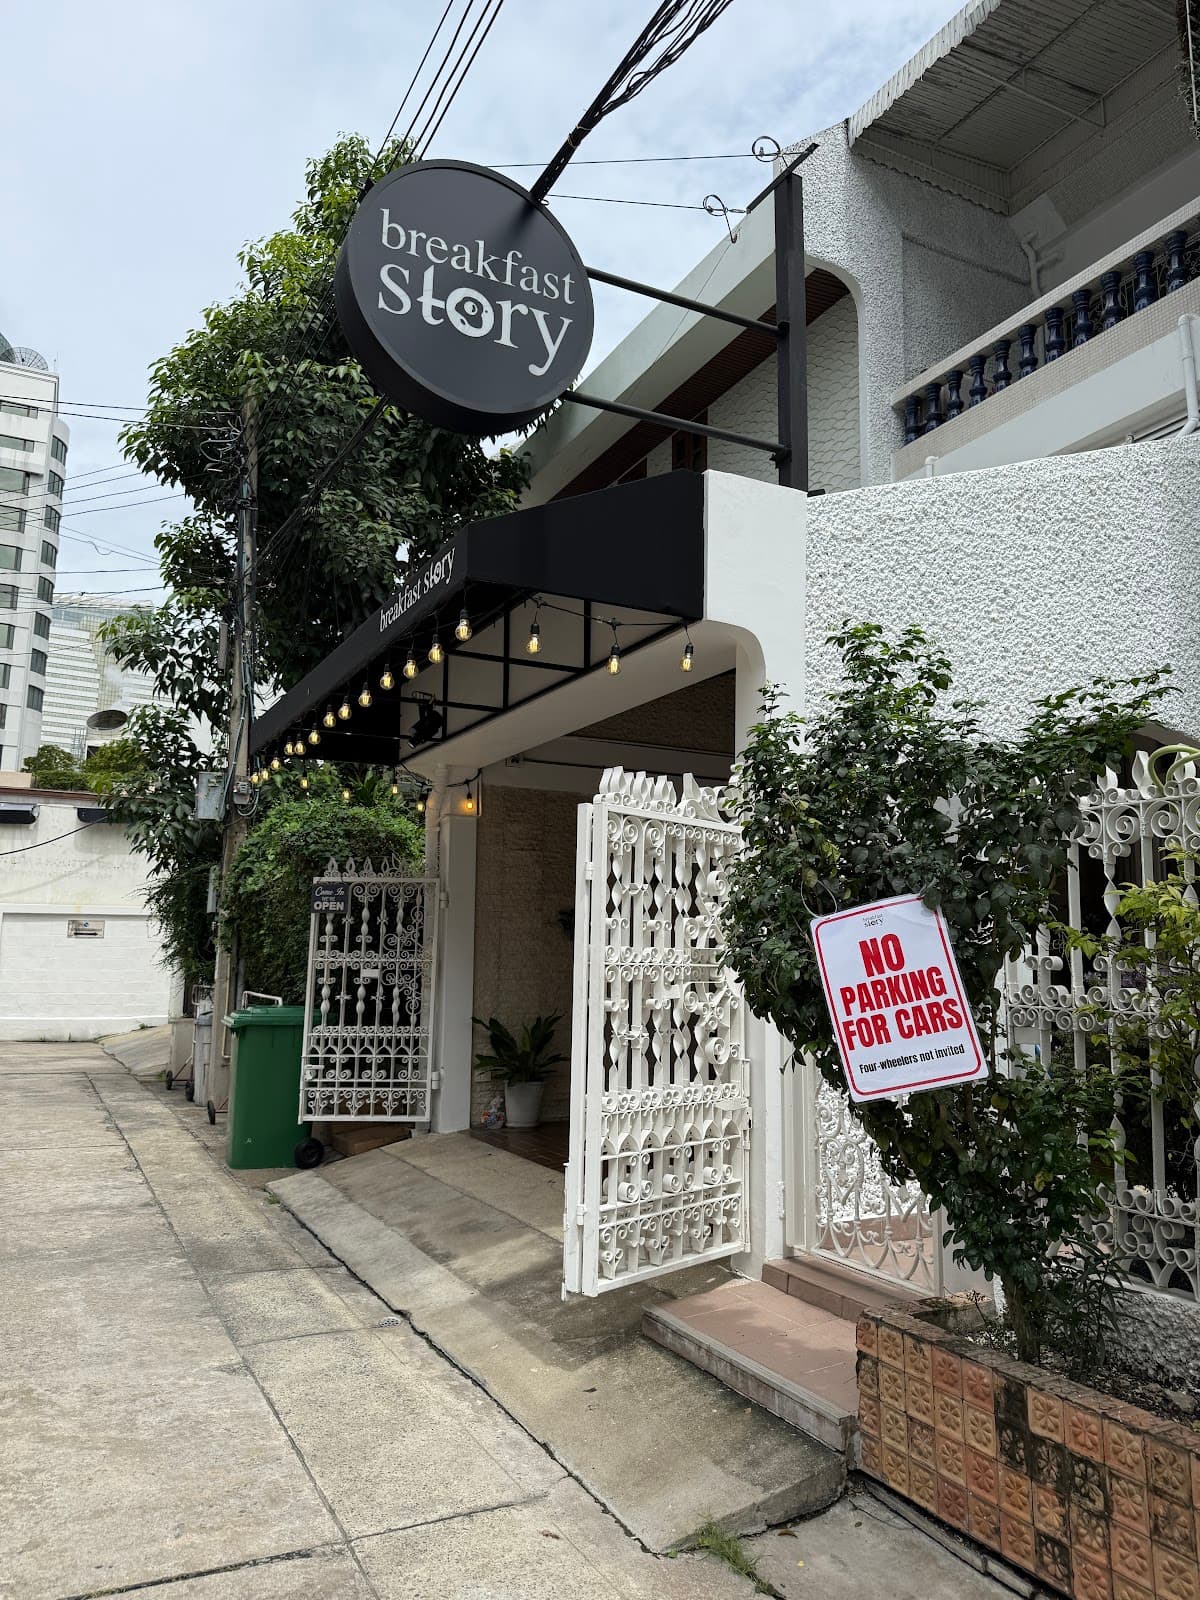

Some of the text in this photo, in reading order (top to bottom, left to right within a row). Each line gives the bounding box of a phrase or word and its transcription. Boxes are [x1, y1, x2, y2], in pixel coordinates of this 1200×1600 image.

[380, 208, 575, 304] breakfast
[380, 547, 455, 632] breakfast story
[313, 901, 344, 910] OPEN
[859, 933, 905, 977] NO
[840, 966, 947, 1017] PARKING
[841, 998, 963, 1050] FOR CARS
[859, 1043, 965, 1074] Four-wheelers not invited
